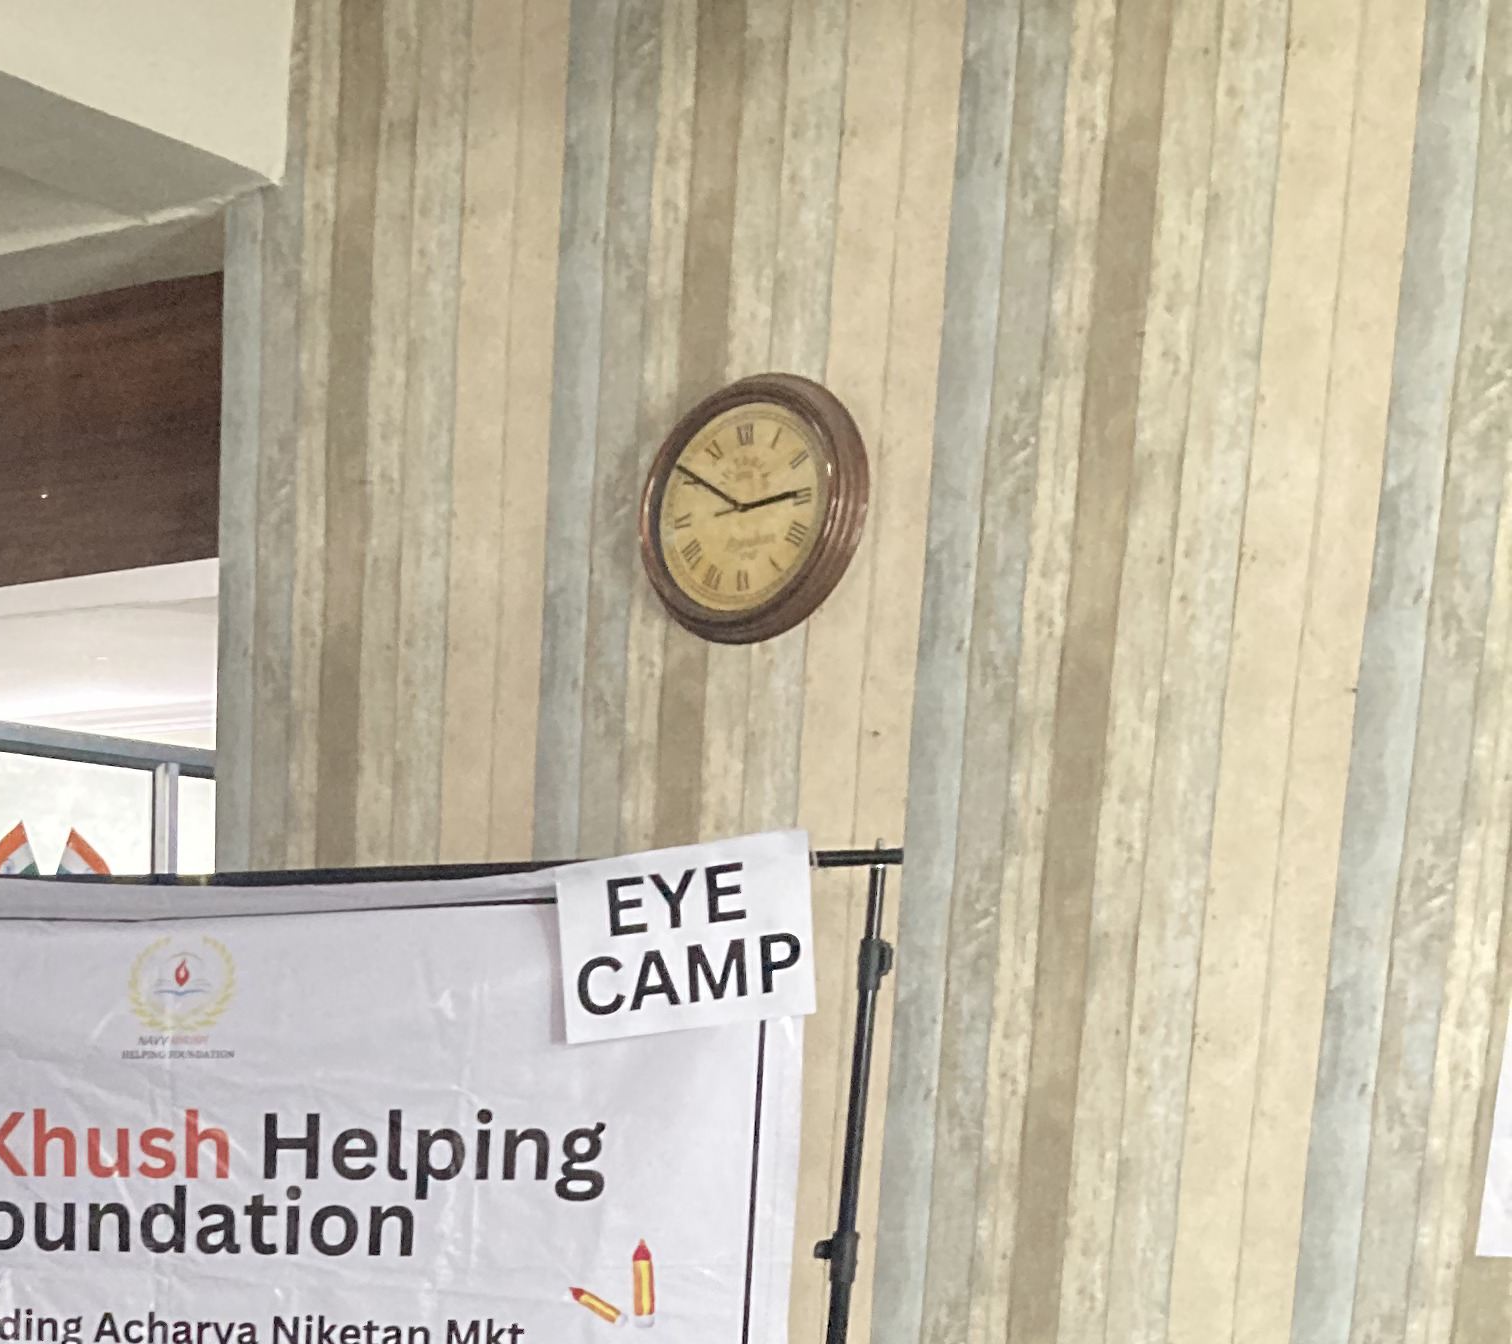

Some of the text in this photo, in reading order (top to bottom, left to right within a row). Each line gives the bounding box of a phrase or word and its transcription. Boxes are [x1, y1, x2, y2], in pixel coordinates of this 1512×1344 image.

[606, 861, 747, 937] EYE
[576, 933, 802, 1016] CAMP
[263, 1109, 607, 1201] Helping
